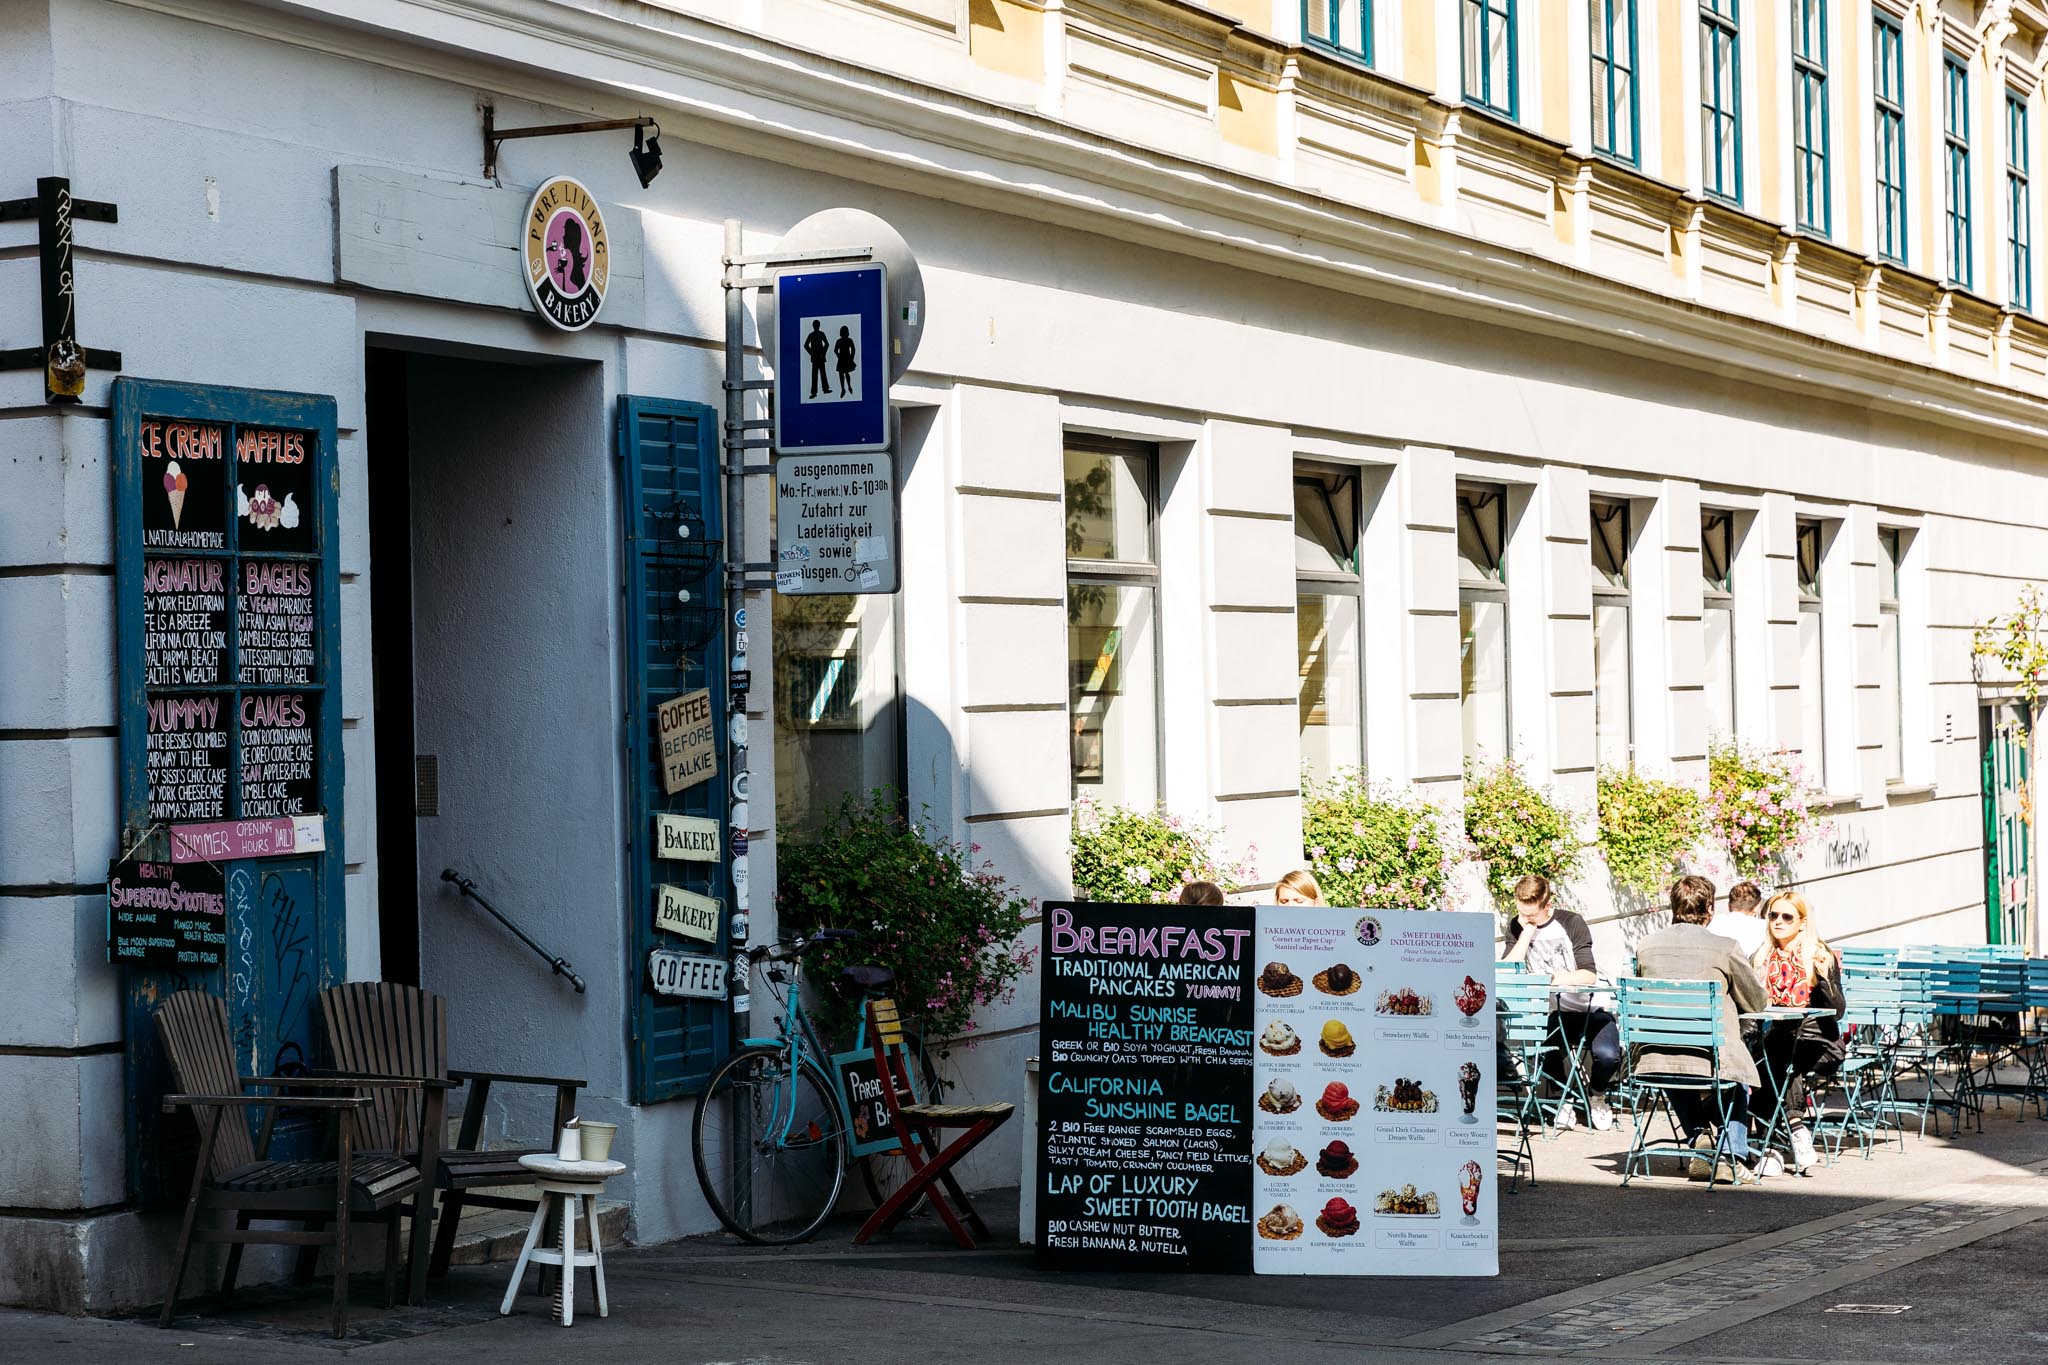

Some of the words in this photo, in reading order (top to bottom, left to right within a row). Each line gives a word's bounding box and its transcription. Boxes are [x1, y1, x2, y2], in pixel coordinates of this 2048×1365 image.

[531, 187, 558, 241] PURE
[565, 184, 605, 254] LIVING
[545, 290, 595, 323] BAKERY
[165, 422, 222, 459] CREAM
[794, 463, 873, 480] ausgenommen
[801, 502, 843, 518] Zufahrt
[849, 504, 868, 517] zur
[149, 529, 224, 549] NATURAL&HOMEMADE
[797, 522, 872, 541] Ladetätigkeit
[819, 543, 852, 558] sowie
[246, 562, 312, 596] BAGELS
[776, 571, 801, 580] TRINKEN
[156, 595, 177, 611] YORK
[178, 595, 224, 611] FLEXITARIAN
[250, 596, 279, 614] VEGAN
[279, 597, 312, 614] PARADISE
[157, 614, 167, 630] IS
[176, 613, 211, 630] BREEZE
[246, 613, 265, 630] FRAN
[265, 615, 286, 631] ASIAN
[287, 615, 313, 632] VEGAN
[182, 632, 202, 648] COOL
[202, 631, 227, 649] CLASSIC
[271, 631, 289, 648] EGGS
[290, 632, 312, 648] BAGEL
[162, 650, 190, 667] PARMA
[191, 650, 218, 667] BEACH
[292, 649, 314, 666] BRITISH
[183, 667, 218, 684] WEALTH
[258, 668, 282, 684] TOOTH
[284, 667, 310, 684] BAGEL
[146, 697, 219, 732] YUMMY
[240, 694, 306, 727] CAKES
[661, 694, 710, 733] COFFEE
[165, 733, 192, 749] BESSIES
[193, 732, 227, 749] CRUMBLES
[284, 728, 312, 745] BANANA
[664, 725, 713, 758] BEFORE
[179, 751, 190, 766] TO
[192, 750, 211, 767] HELL
[251, 746, 270, 763] OREO
[270, 745, 294, 762] COOKIE
[295, 744, 313, 761] CAKE
[669, 752, 712, 781] TALKIE
[187, 769, 206, 783] CHOC
[207, 768, 227, 783] CAKE
[156, 786, 176, 801] YORK
[178, 784, 224, 800] CHEESECAKE
[268, 782, 288, 798] CAKE
[188, 801, 210, 818] APPLE
[211, 801, 223, 817] PIE
[283, 798, 302, 814] CAKE
[236, 821, 273, 837] OPENING
[275, 827, 293, 848] DAILY
[663, 824, 717, 851] BAKERY
[175, 831, 230, 859] SUMMER
[242, 838, 269, 854] HOURS
[139, 863, 174, 880] HEALTHY
[118, 911, 133, 922] WIDE
[135, 913, 157, 923] AWAKE
[663, 895, 716, 931] BAKERY
[174, 919, 194, 930] MANGO
[1264, 927, 1306, 936] TAKEAWAY
[1307, 928, 1346, 937] COUNTER
[130, 937, 147, 946] MOON
[148, 937, 175, 947] SUPERFOOD
[203, 932, 225, 944] BOOSTER
[1051, 908, 1250, 961] BREAKFAST
[1402, 931, 1428, 939] SWEET
[1430, 932, 1463, 940] DREAMS
[118, 947, 145, 957] SURPRISE
[1390, 939, 1441, 947] INDULGENCE
[1442, 940, 1474, 948] CORNER
[178, 951, 199, 962] PROTEIN
[200, 952, 218, 963] POWER
[657, 958, 722, 991] COFFEE
[1051, 956, 1153, 979] TRADITIONAL
[1158, 963, 1240, 981] AMERICAN
[1089, 977, 1175, 997] PANCAKES
[1186, 983, 1241, 1001] YUMMY!
[1050, 1000, 1117, 1021] MALIBU
[1129, 1004, 1197, 1024] SUNRISE
[1089, 1021, 1164, 1040] HEALTHY
[1170, 1026, 1254, 1047] BREAKFAST
[1052, 1040, 1083, 1050] GREEK
[1087, 1042, 1099, 1050] OR
[1103, 1041, 1120, 1052] BIO
[1123, 1043, 1147, 1052] SOYA
[1195, 1046, 1217, 1055] FRESH
[1219, 1048, 1252, 1057] BANANA,
[1052, 1052, 1068, 1062] BIO
[1071, 1052, 1109, 1063] CRUNCHY
[1112, 1053, 1137, 1064] OATS
[1141, 1054, 1175, 1064] TOPPED
[1180, 1055, 1201, 1064] WITH
[1205, 1056, 1227, 1065] CHIA
[1229, 1058, 1253, 1067] SEEDS
[849, 1071, 899, 1103] PARADE
[1048, 1071, 1163, 1096] CALIFORNIA
[1085, 1098, 1176, 1119] SUNSHINE
[1184, 1103, 1241, 1123] BAGEL
[1062, 1122, 1080, 1132] BIO
[1083, 1122, 1105, 1133] FREE
[1108, 1124, 1141, 1135] RANGE
[1146, 1126, 1202, 1137] SCRAMBLED
[1206, 1128, 1236, 1139] EGGS,
[1048, 1134, 1096, 1145] ATLANTIC
[1101, 1137, 1136, 1147] SMOKED
[1143, 1138, 1179, 1148] SALMON
[1048, 1145, 1074, 1155] SILKY
[1077, 1147, 1110, 1157] CREAM
[1115, 1149, 1154, 1161] CHEESE,
[1156, 1151, 1183, 1161] FANCY
[1187, 1151, 1210, 1161] FIELD
[1213, 1153, 1252, 1165] LETTUCE,
[1049, 1156, 1079, 1166] TASTY
[1083, 1158, 1122, 1171] TOMATO,
[1123, 1161, 1163, 1170] CRUNCHY
[1166, 1162, 1214, 1173] CUCUMBER
[1048, 1172, 1083, 1195] LAP
[1090, 1174, 1115, 1194] OF
[1122, 1175, 1199, 1196] LUXURY
[1083, 1197, 1142, 1216] SWEET
[1146, 1198, 1198, 1219] TOOTH
[1202, 1202, 1250, 1223] BAGEL
[1048, 1220, 1067, 1232] BIO
[1069, 1220, 1110, 1233] CASHEW
[1113, 1223, 1135, 1235] NUT
[1138, 1224, 1181, 1239] BUTTER
[1048, 1234, 1079, 1248] FRESH
[1082, 1236, 1126, 1250] BANANA
[1128, 1239, 1139, 1252] &
[1141, 1240, 1187, 1255] NUTELLA
